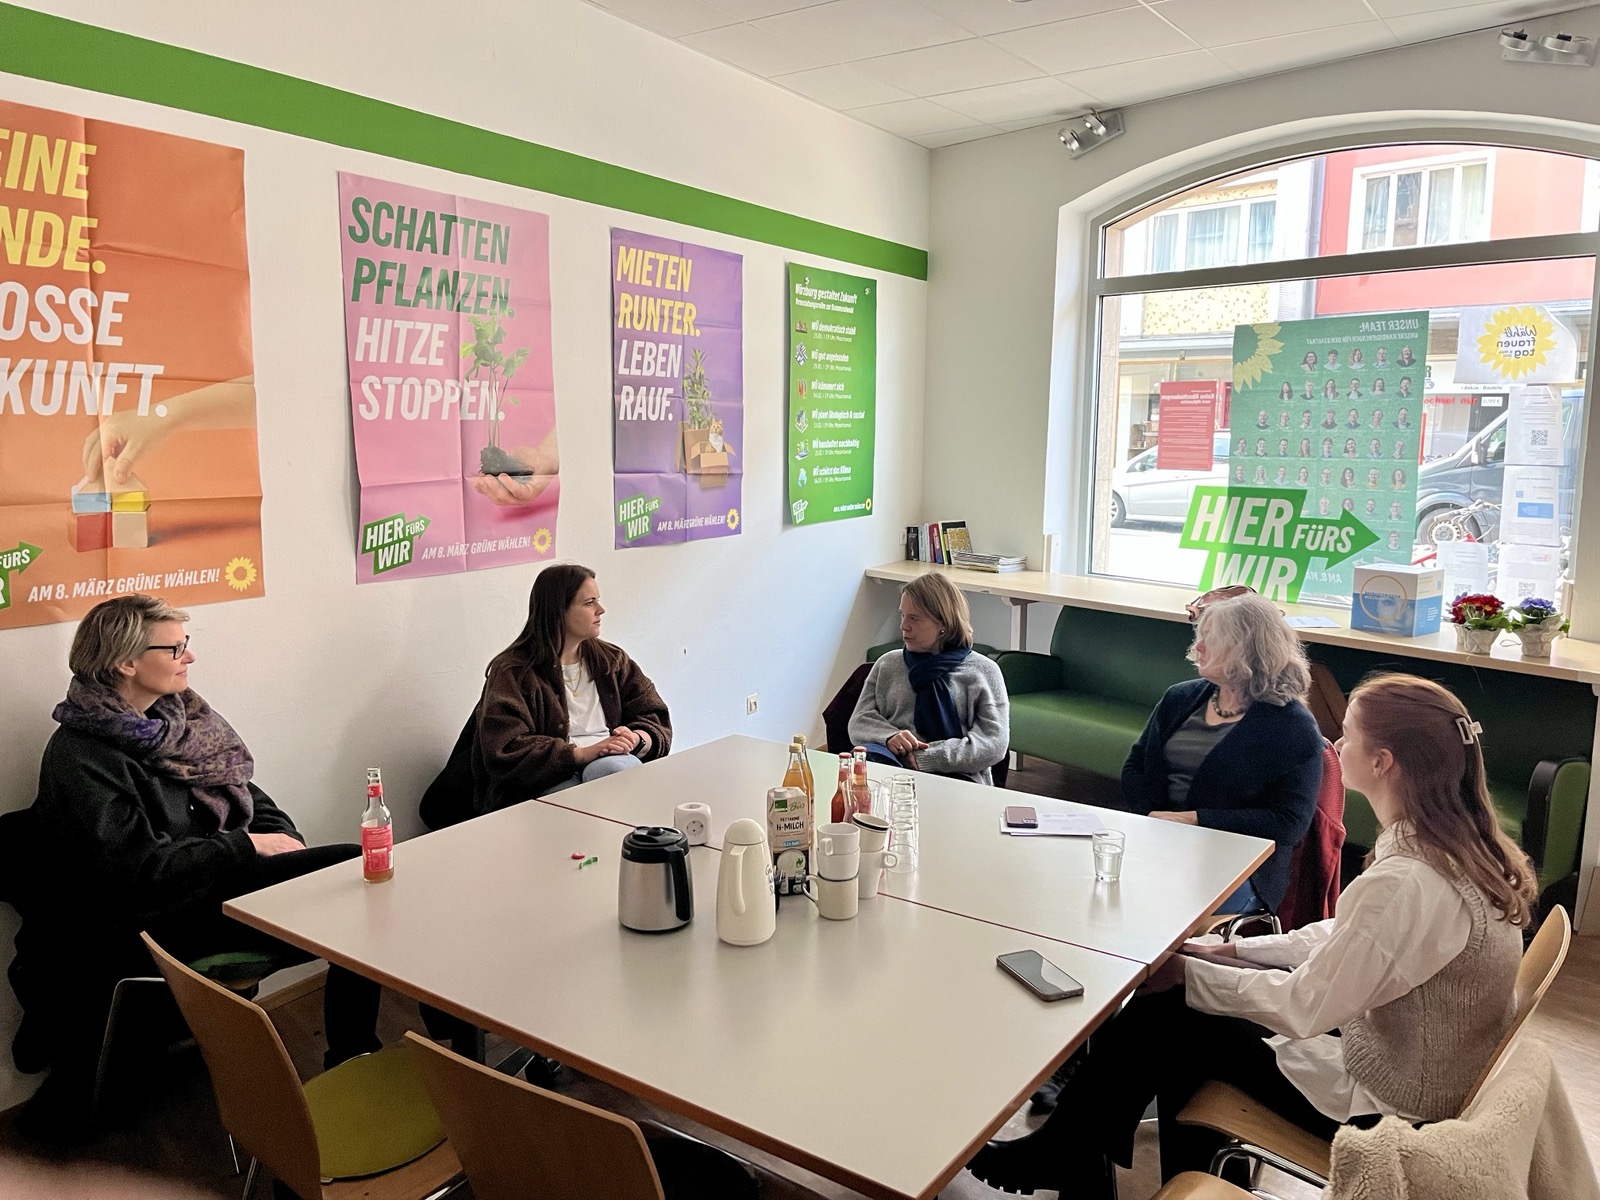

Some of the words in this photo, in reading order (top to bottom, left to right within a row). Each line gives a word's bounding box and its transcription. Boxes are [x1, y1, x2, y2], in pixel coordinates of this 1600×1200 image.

[0, 128, 97, 200] INE
[348, 197, 511, 265] SCHATTEN
[351, 257, 511, 316] PFLANZEN
[616, 245, 693, 292] MIETEN
[0, 281, 129, 346] OSSE
[618, 292, 700, 337] RUNTER.
[355, 316, 449, 366] HITZE
[618, 339, 682, 378] LEBEN
[0, 357, 168, 417] KUNFT.
[358, 375, 505, 421] STOPPEN.
[619, 385, 674, 421] RAUF.
[619, 497, 645, 522] HIER
[627, 515, 649, 539] WIR
[1190, 495, 1294, 549] HIER
[1291, 524, 1355, 553] FÜRS
[365, 517, 405, 550] HIER
[405, 520, 425, 537] FÜRS
[378, 540, 411, 570] WIR
[422, 547, 437, 560] AM
[437, 546, 445, 558] 8.
[447, 542, 468, 556] MÄRZ
[470, 539, 497, 554] GRÜNE
[498, 535, 531, 551] WÄHLEN!
[27, 584, 53, 603] AM
[55, 583, 69, 600] 8.
[72, 577, 113, 598] MÄRZ
[116, 573, 162, 593] GRÜNE
[164, 568, 220, 587] WÄHLEN!
[1211, 552, 1297, 603] WIR
[776, 821, 804, 831] H-MILCH
[789, 801, 805, 811] Bio
